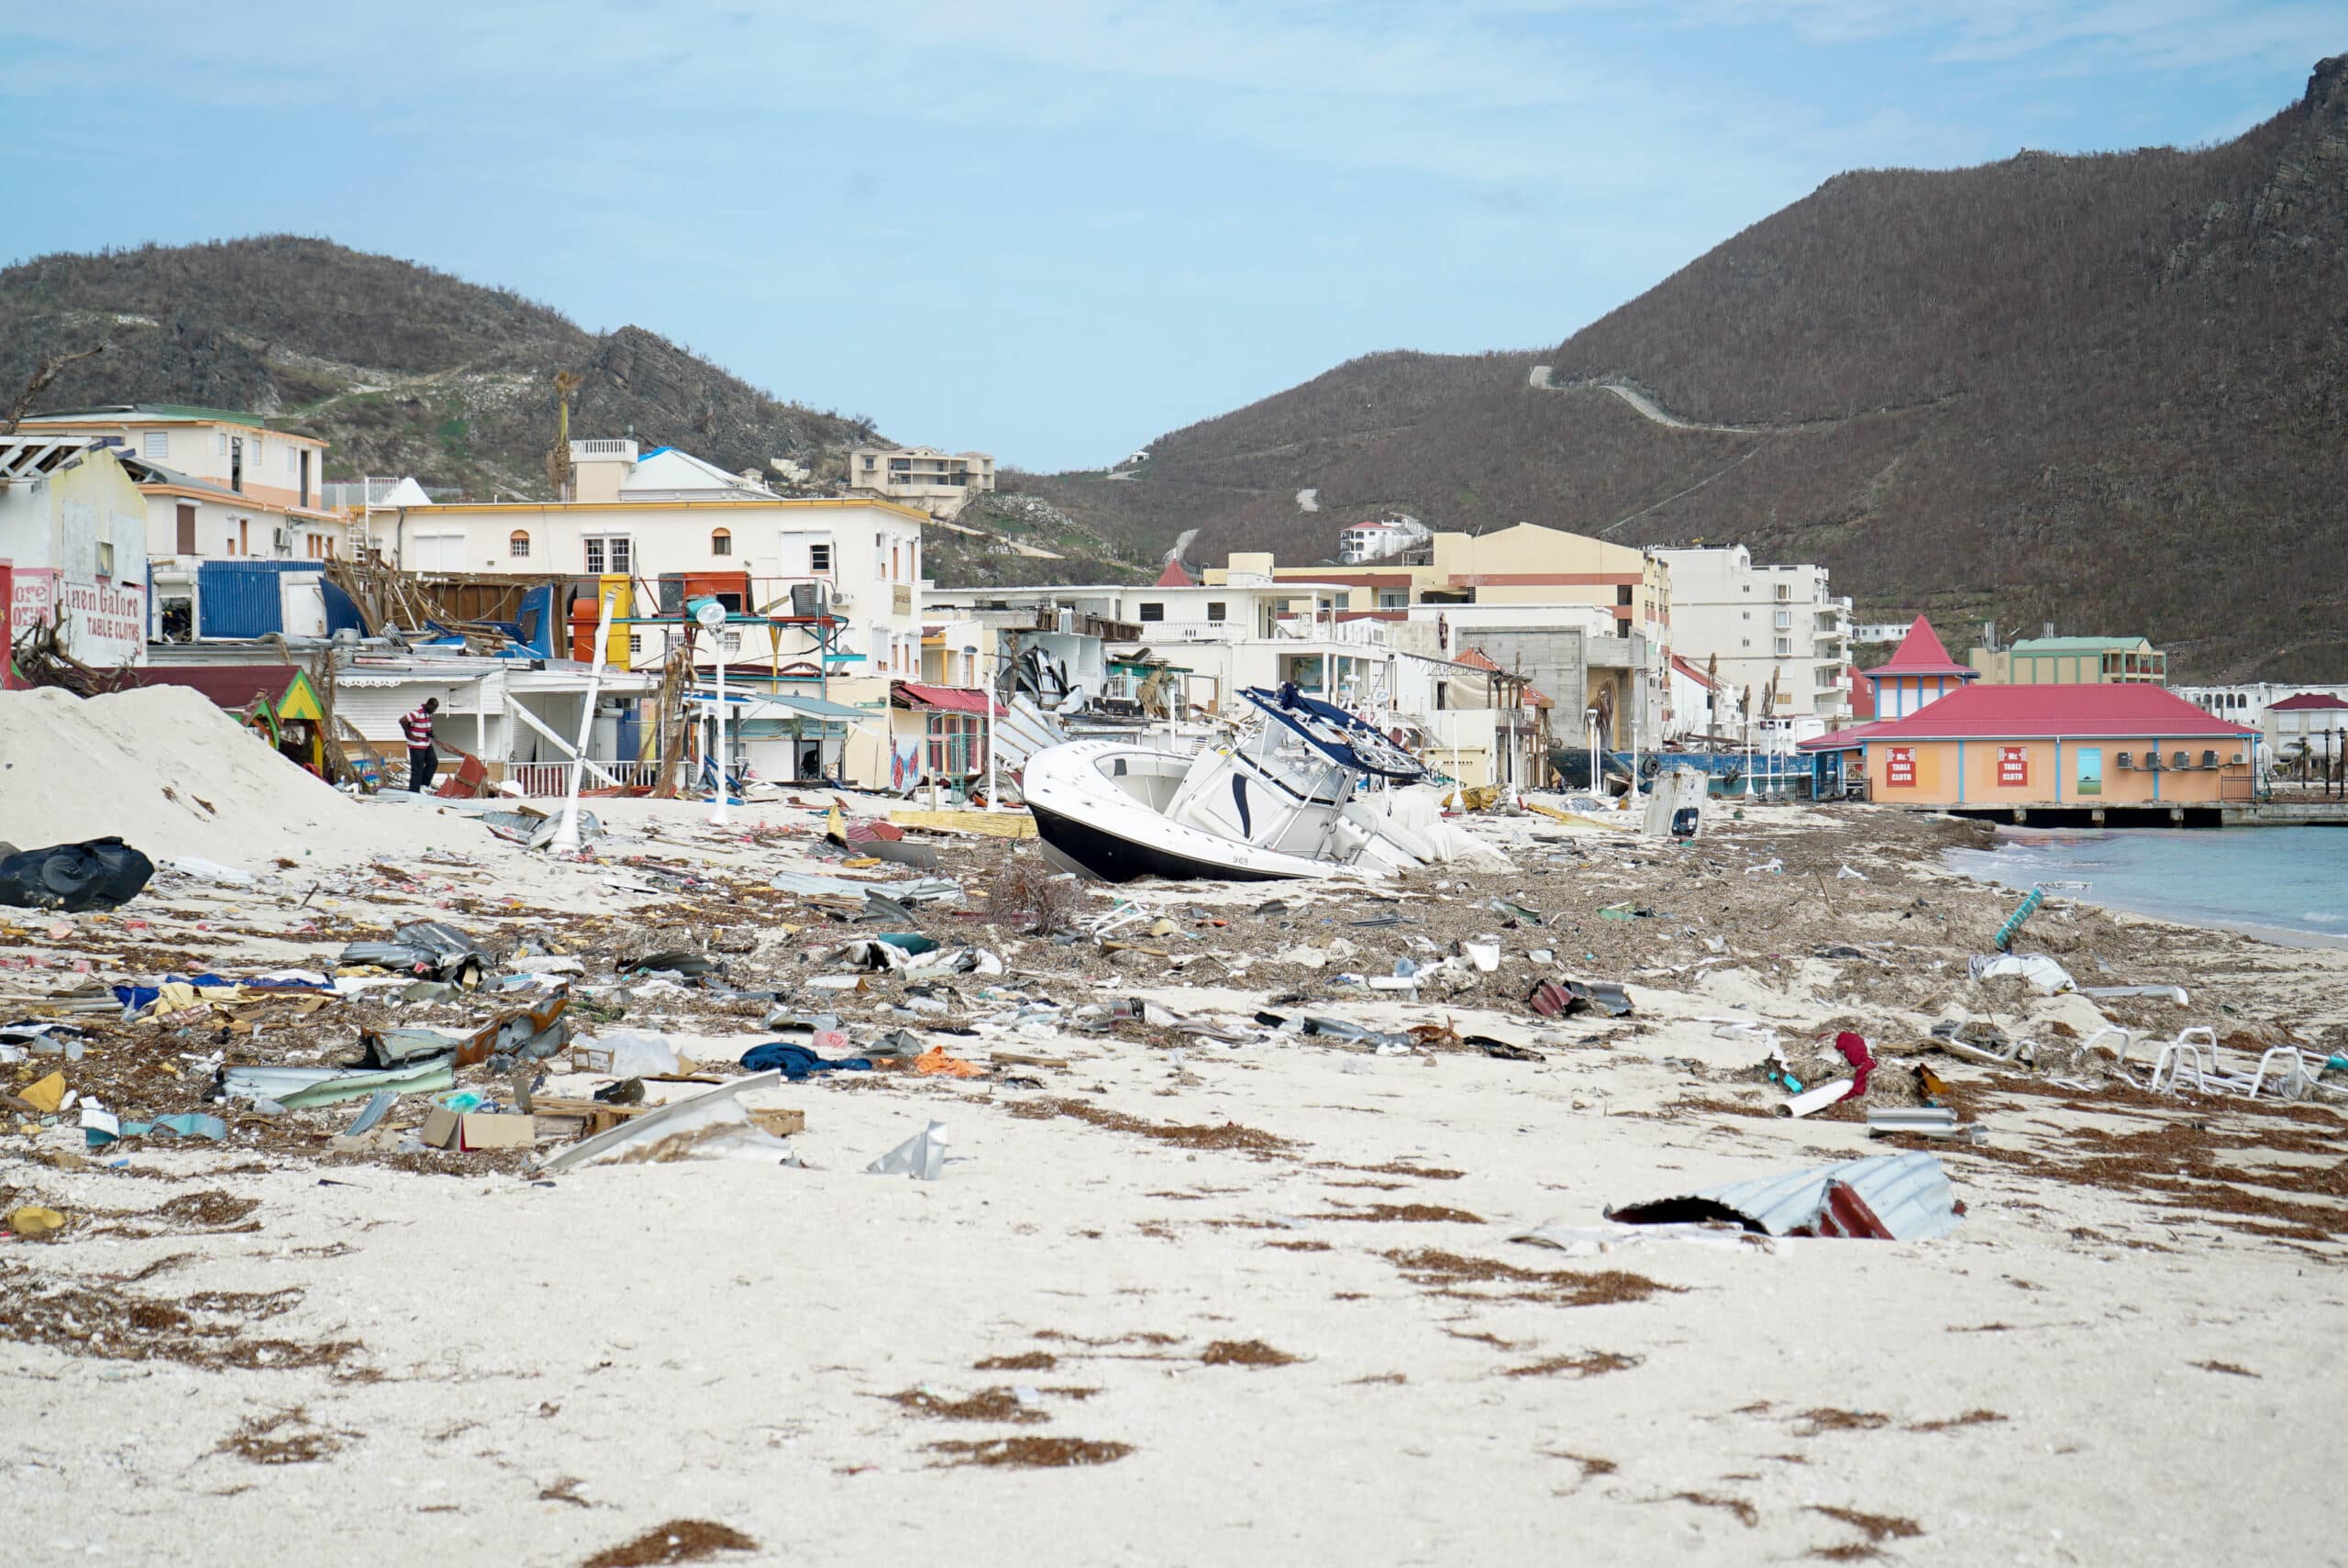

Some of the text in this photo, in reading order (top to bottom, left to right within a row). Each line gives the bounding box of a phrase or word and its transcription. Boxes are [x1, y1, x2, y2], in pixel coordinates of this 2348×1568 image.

[14, 586, 48, 602] ore
[100, 585, 138, 618] Galore
[87, 616, 139, 641] TABLE CLOTHS
[1892, 763, 1911, 771] TABLE
[1891, 773, 1912, 781] CLOTH
